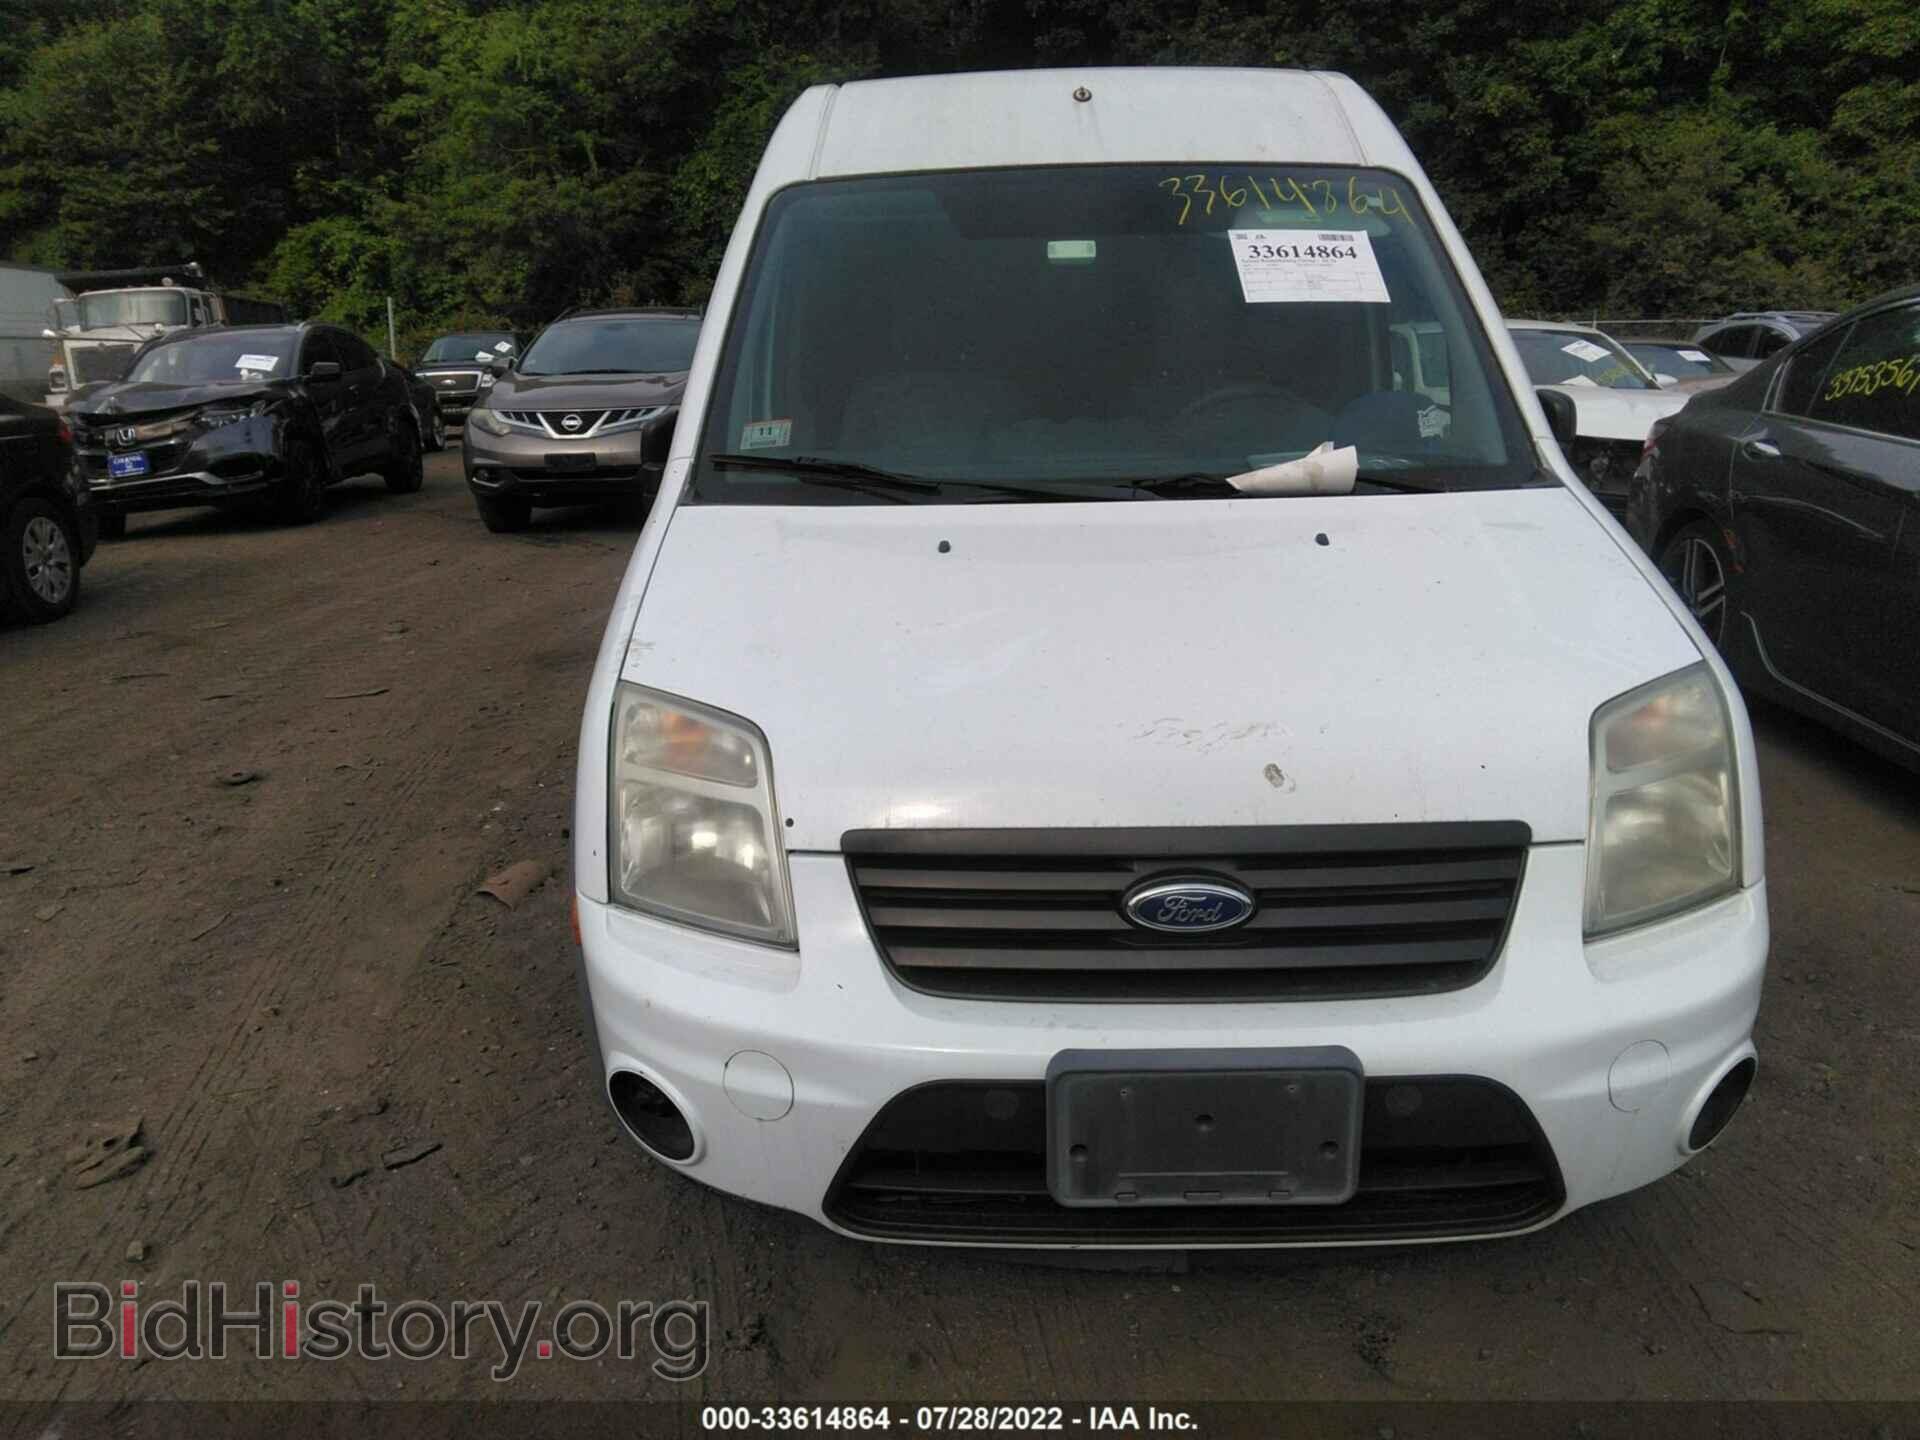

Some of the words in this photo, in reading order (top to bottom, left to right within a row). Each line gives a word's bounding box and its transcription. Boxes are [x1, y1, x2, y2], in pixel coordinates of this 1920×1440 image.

[1159, 174, 1415, 225] 33614864
[1248, 244, 1357, 259] 33614864
[1156, 895, 1223, 922] Ford
